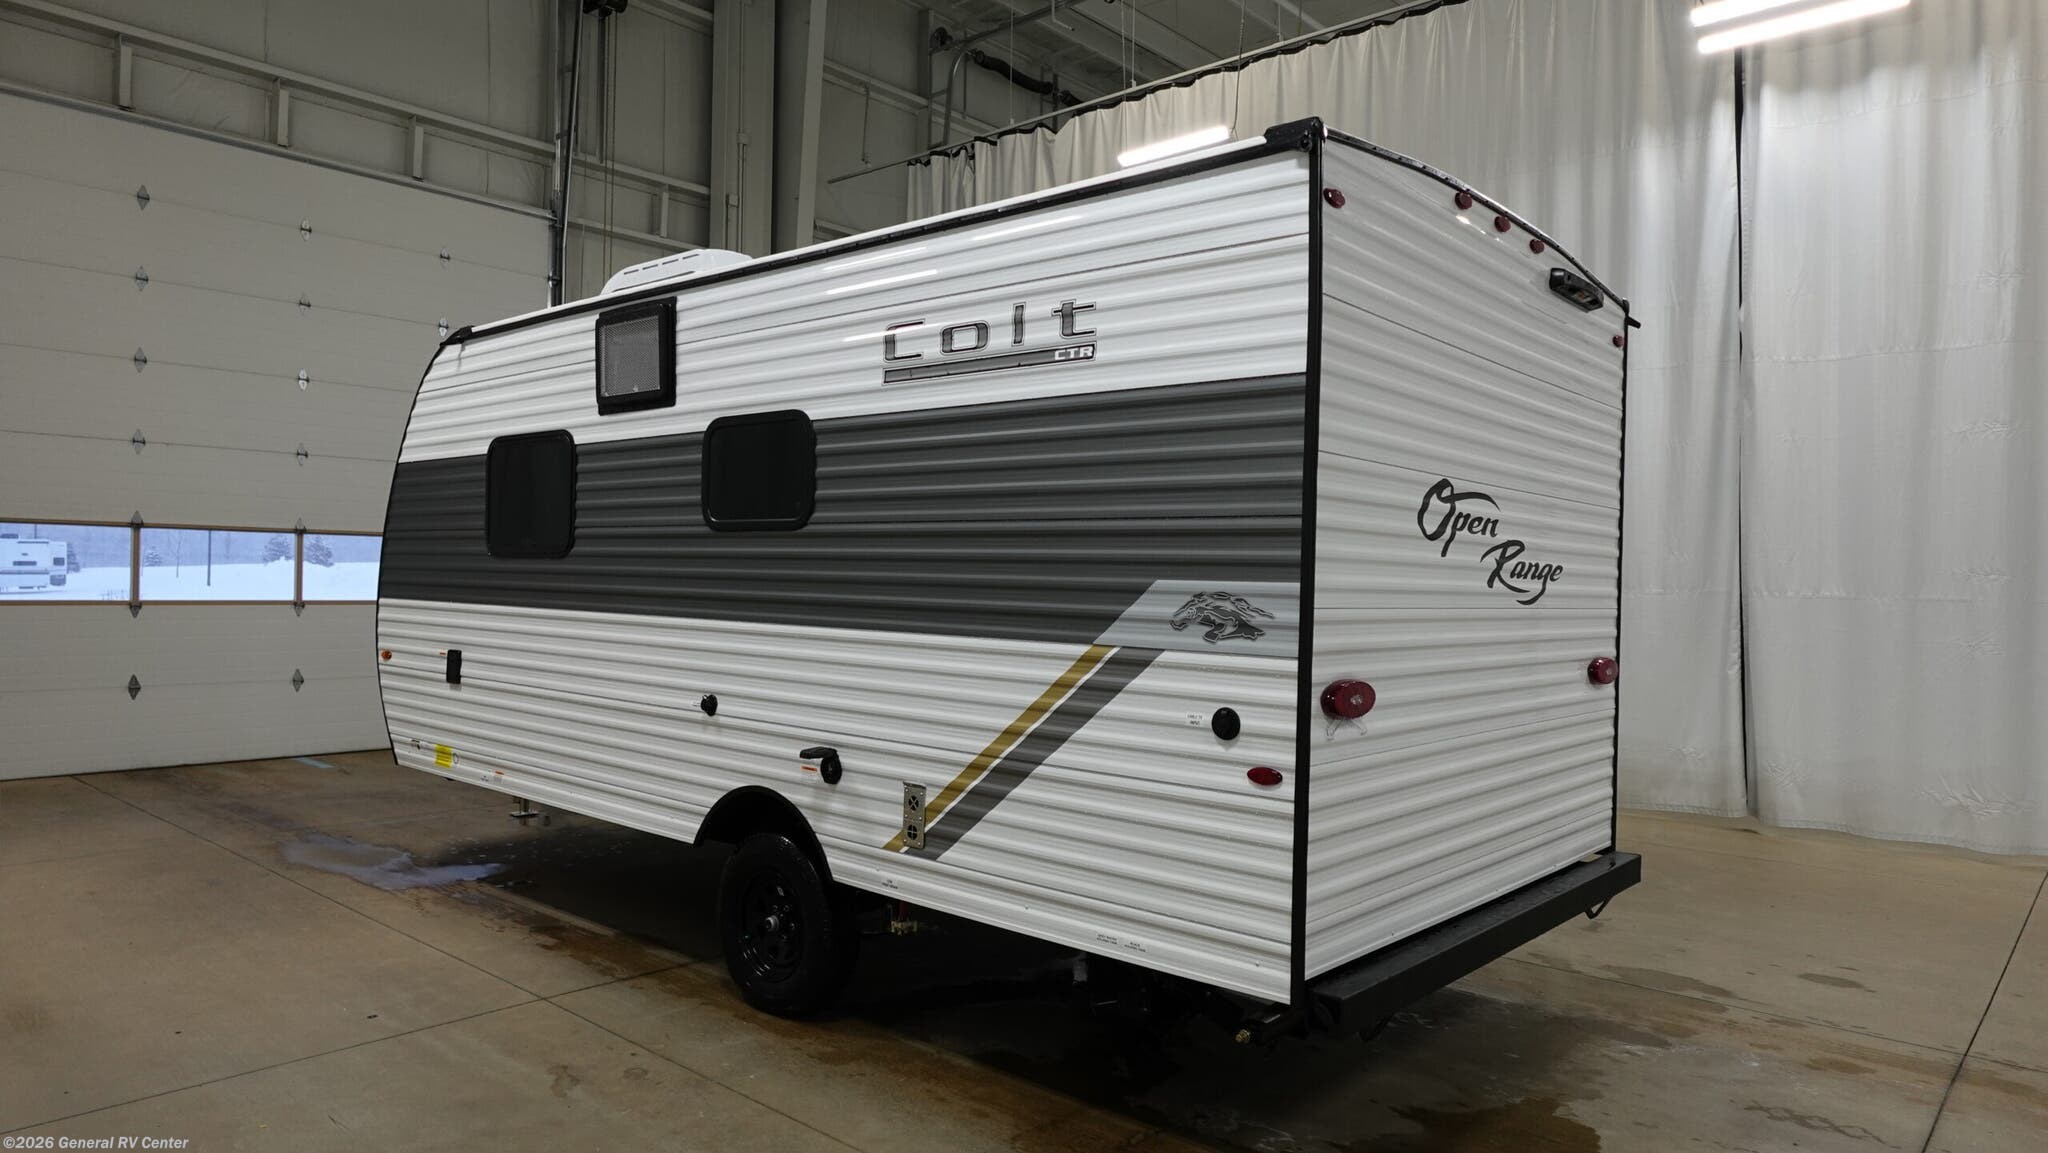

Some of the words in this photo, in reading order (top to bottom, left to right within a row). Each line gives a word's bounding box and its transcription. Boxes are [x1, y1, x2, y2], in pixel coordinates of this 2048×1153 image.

[883, 299, 1096, 363] Colt
[1054, 345, 1093, 361] CTR
[1417, 478, 1500, 558] Open
[1480, 540, 1563, 605] Range
